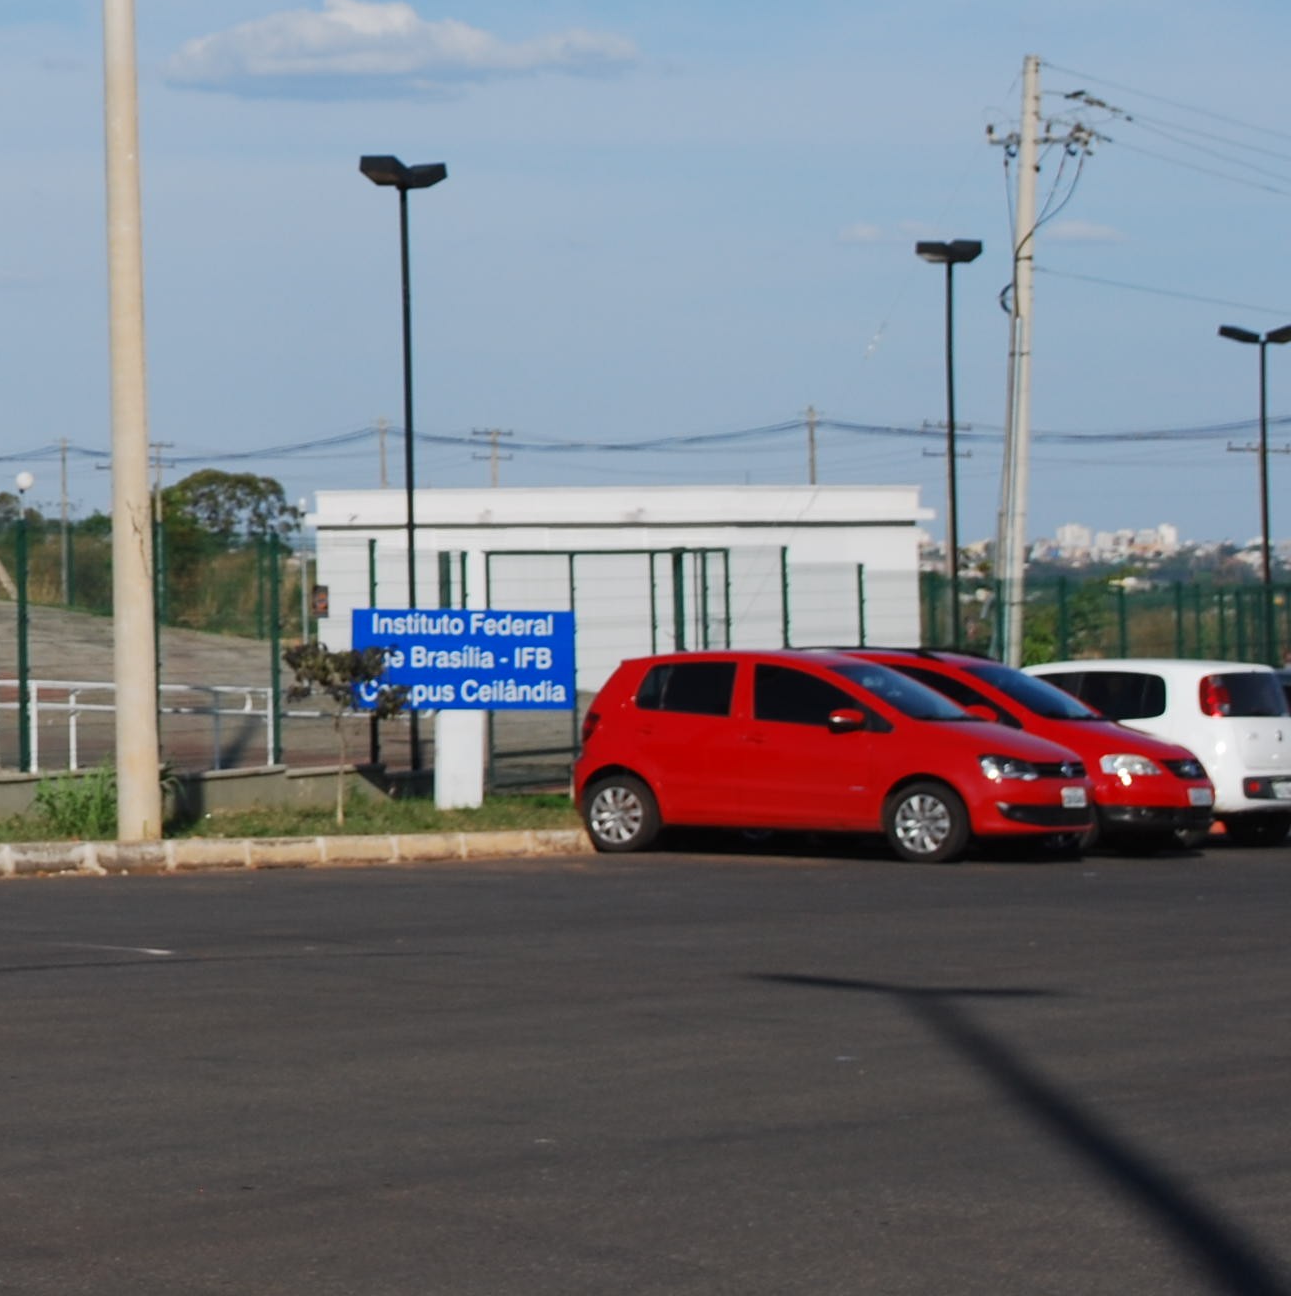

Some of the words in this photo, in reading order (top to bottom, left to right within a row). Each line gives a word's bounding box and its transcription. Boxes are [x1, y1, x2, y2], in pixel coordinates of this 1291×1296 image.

[372, 612, 465, 635] Instituto
[470, 613, 554, 636] Federal
[410, 645, 495, 669] Brasília
[514, 647, 553, 670] IFB
[359, 679, 455, 707] Cpus
[460, 678, 567, 703] Ceilândia
